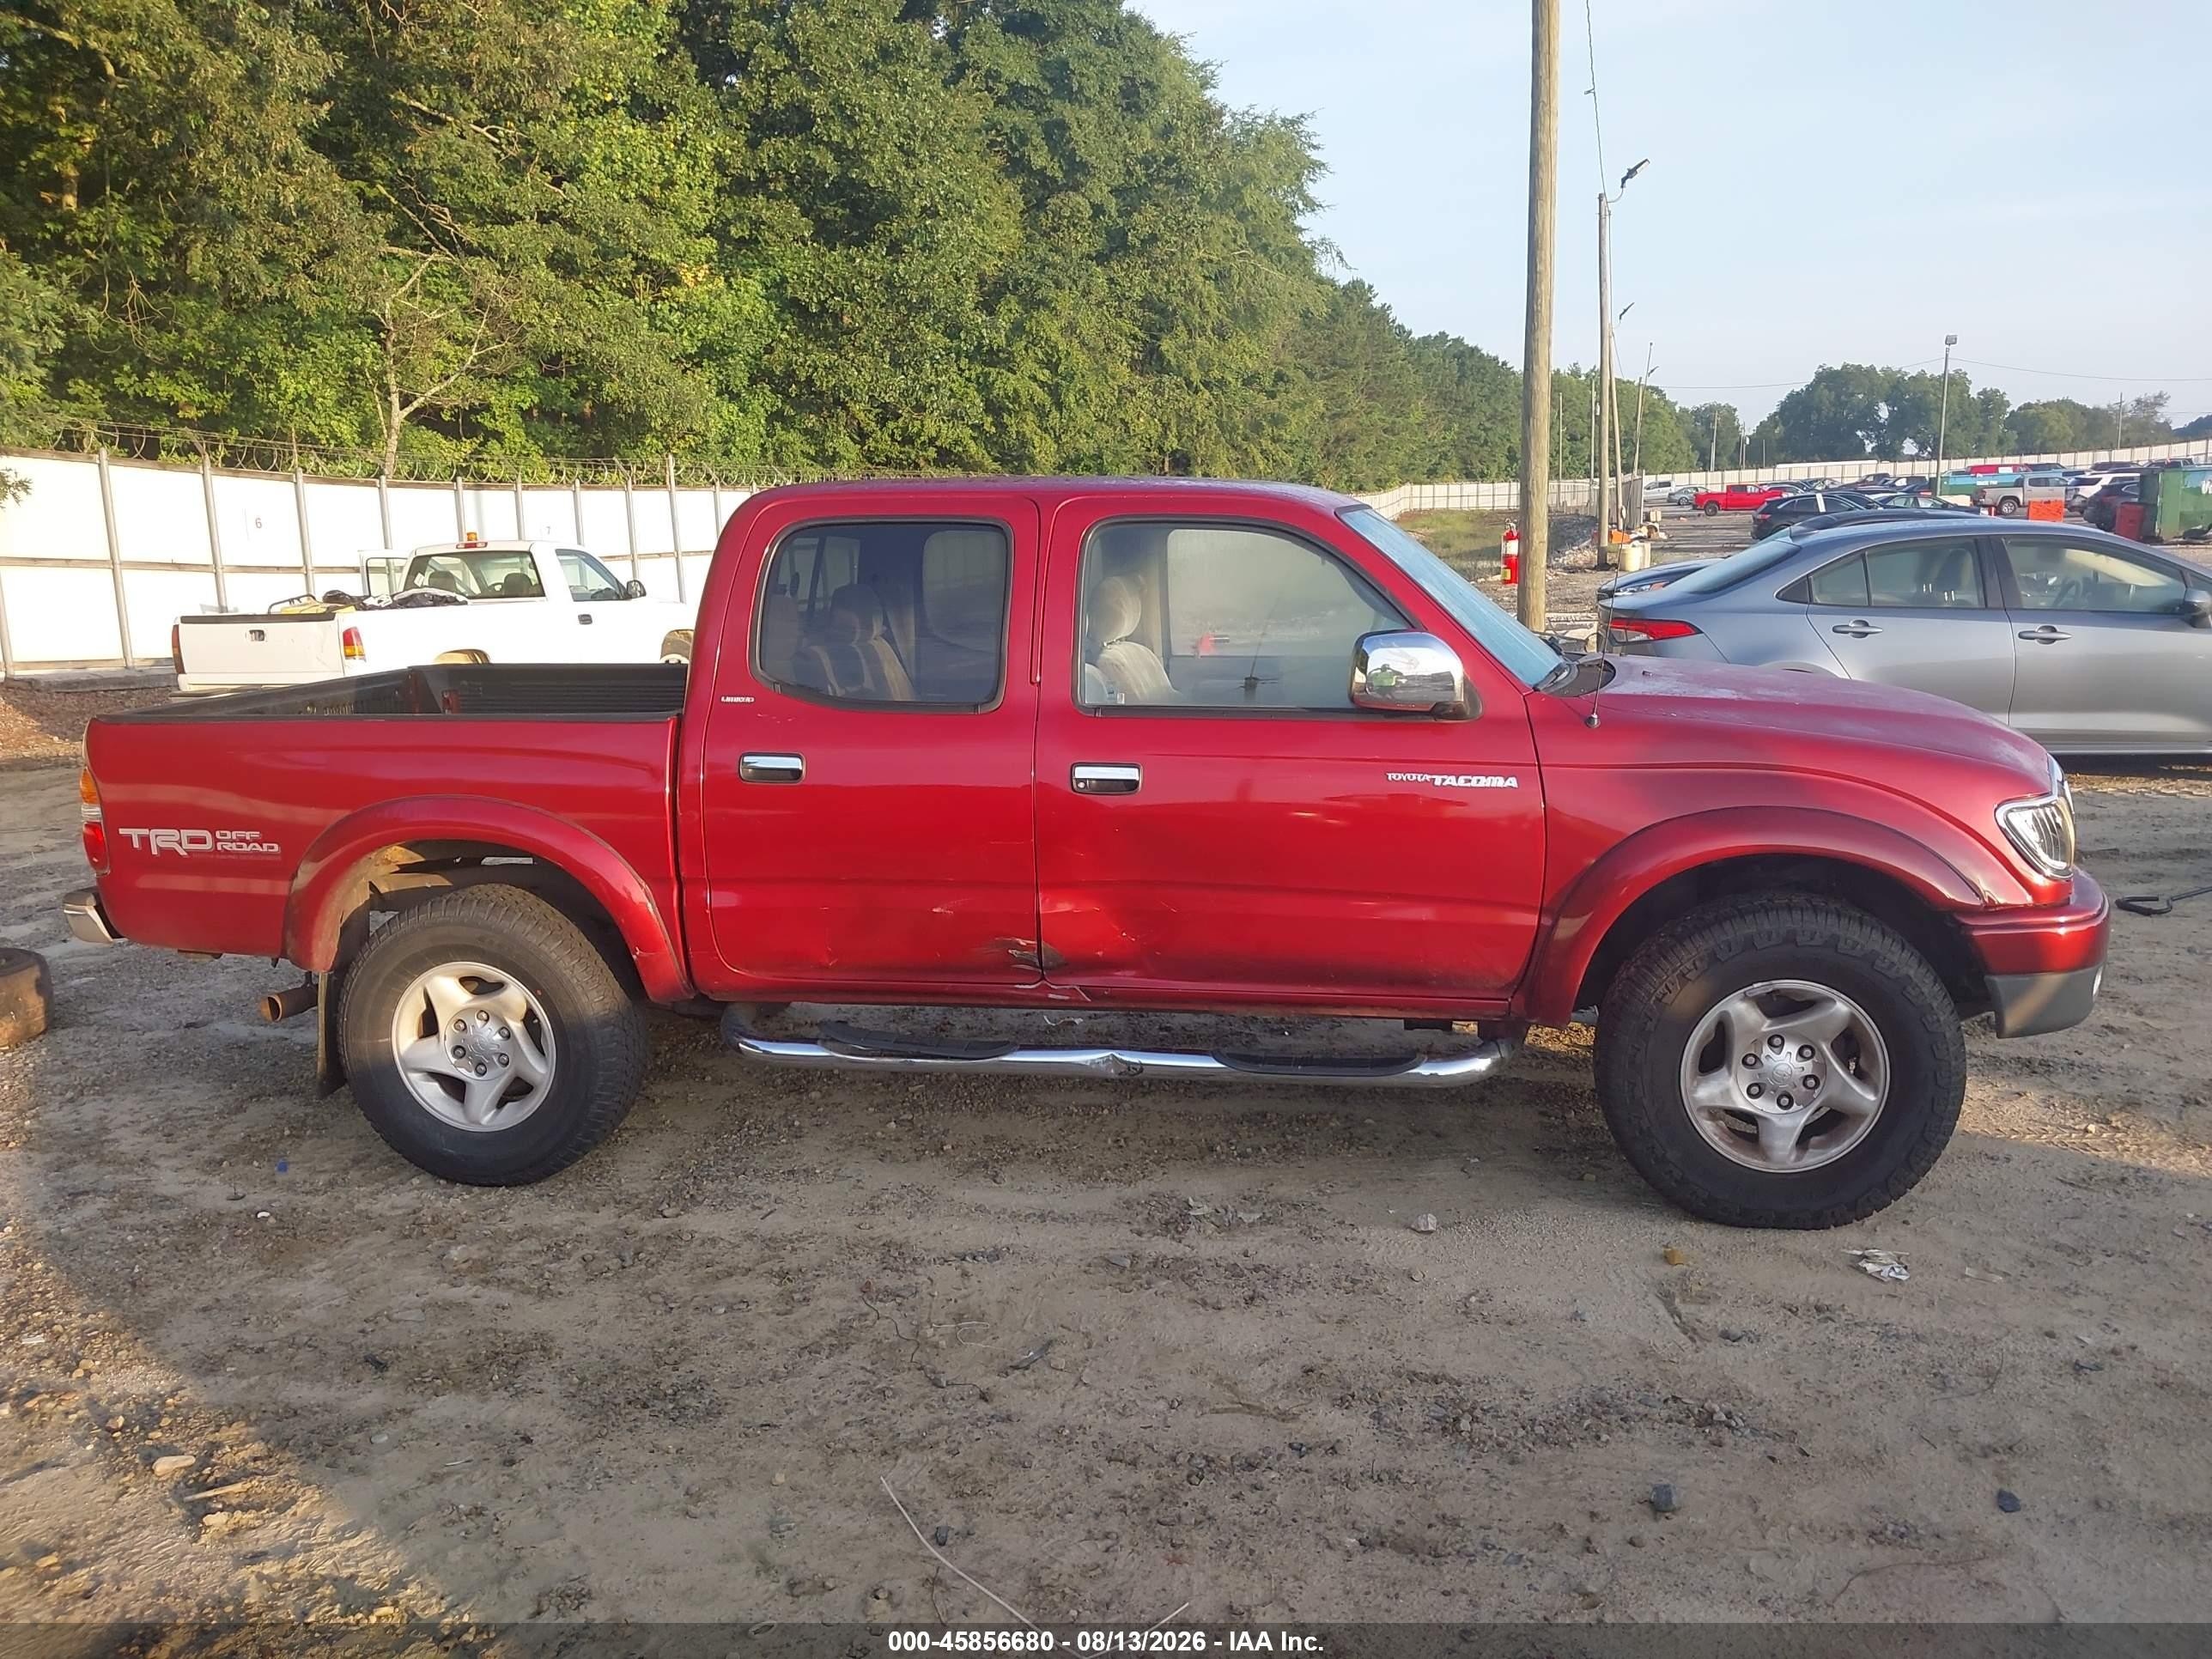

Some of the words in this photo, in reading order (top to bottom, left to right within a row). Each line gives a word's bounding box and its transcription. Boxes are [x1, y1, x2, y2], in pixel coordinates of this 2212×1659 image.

[255, 517, 262, 529] 6
[1386, 772, 1431, 782] TOYOTA
[1430, 775, 1519, 788] TACOMA
[215, 830, 261, 840] OFF
[118, 828, 213, 856] TRD
[216, 842, 281, 853] ROAD
